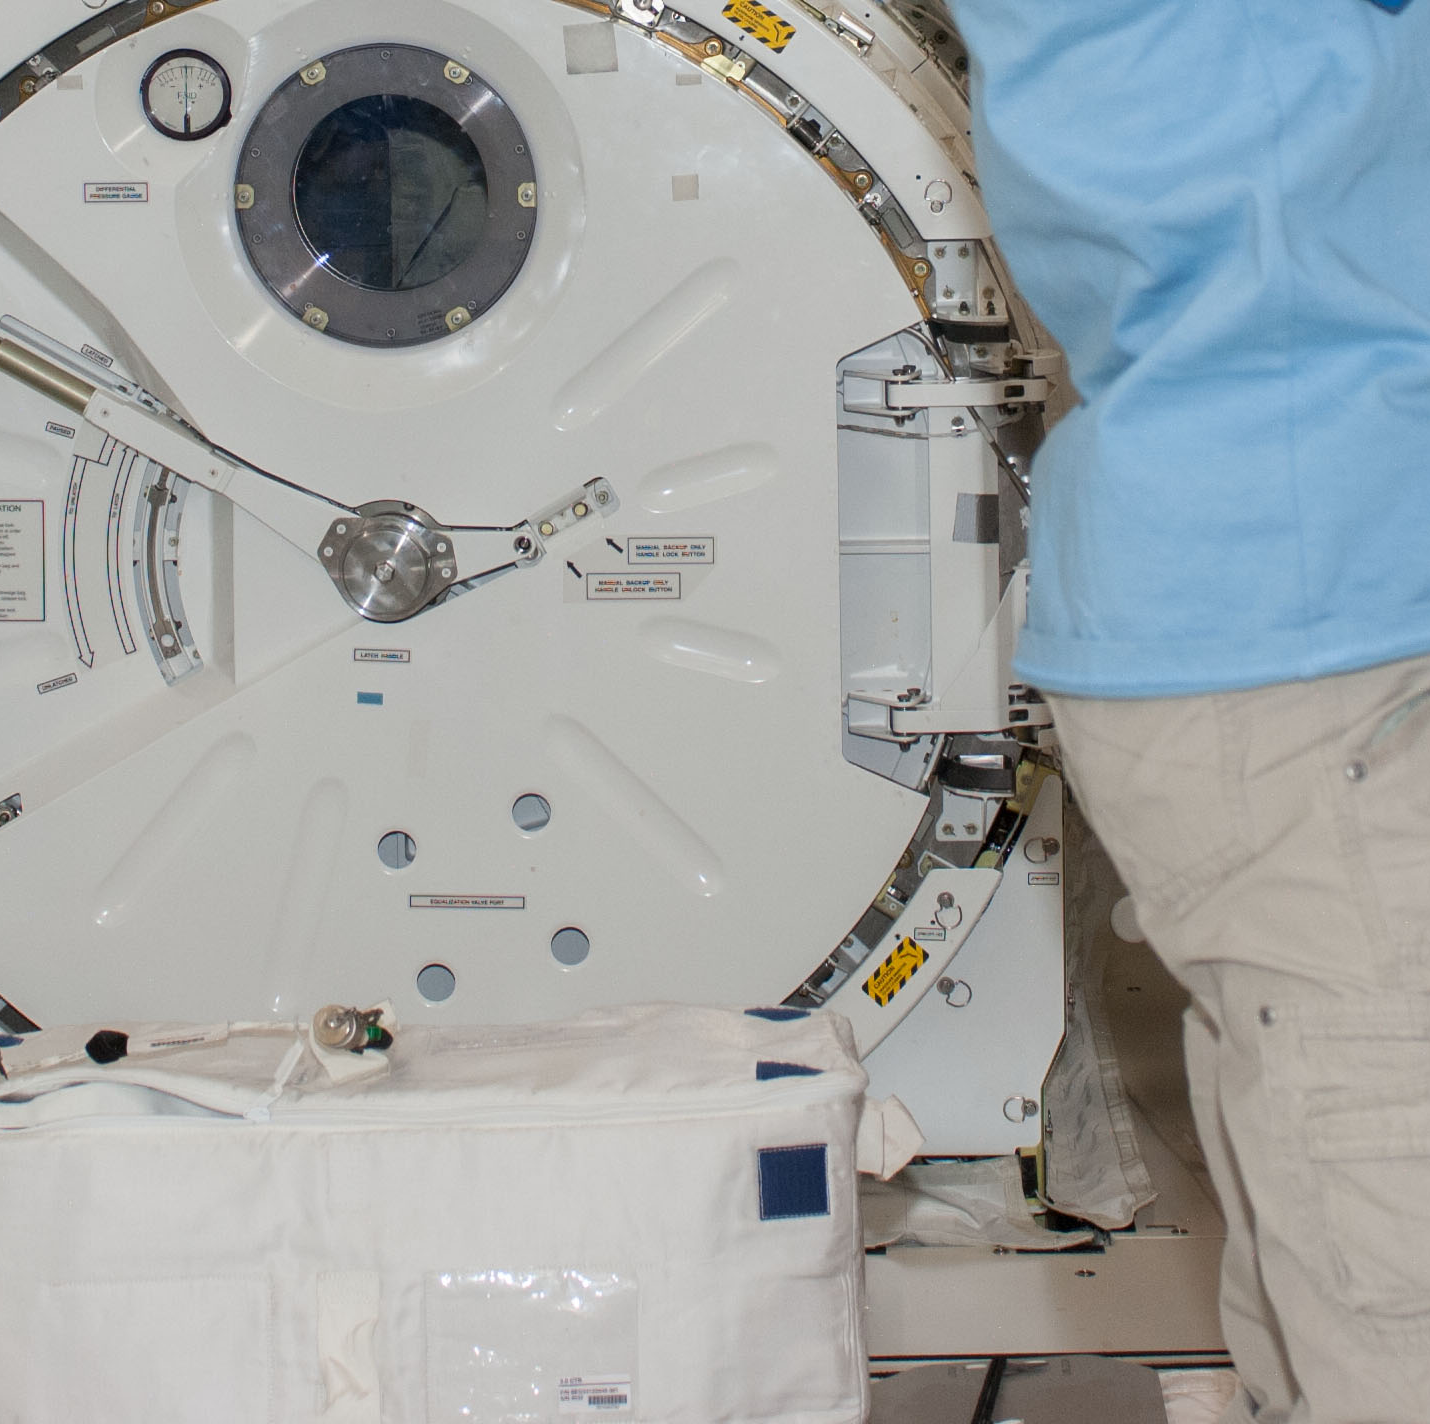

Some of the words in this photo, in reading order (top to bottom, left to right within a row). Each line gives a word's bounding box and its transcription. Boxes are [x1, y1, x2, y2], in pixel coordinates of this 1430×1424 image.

[739, 0, 765, 21] CAUTION
[85, 346, 110, 365] LATCHED
[49, 425, 71, 436] PAUSED
[42, 677, 73, 690] UNLATCHED
[873, 965, 896, 989] CAUTION
